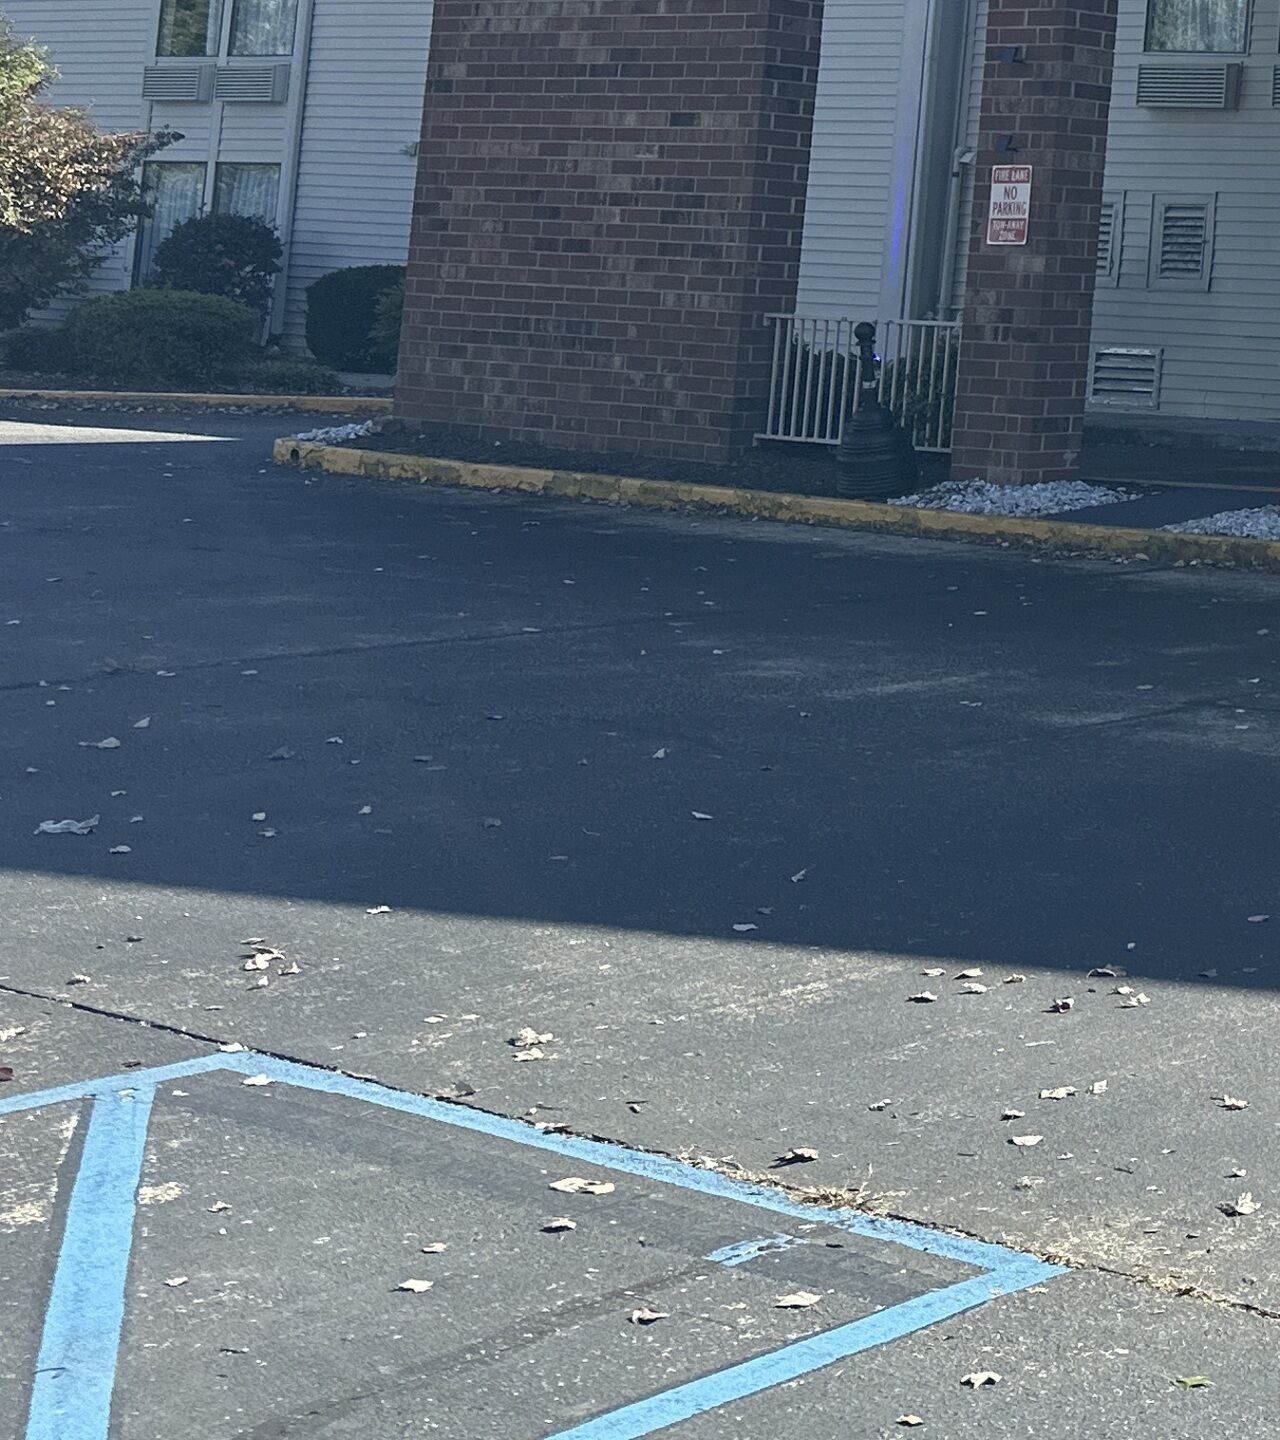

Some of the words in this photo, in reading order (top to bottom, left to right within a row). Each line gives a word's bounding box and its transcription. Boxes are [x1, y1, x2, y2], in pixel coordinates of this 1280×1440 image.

[995, 169, 1010, 181] FIRE
[1011, 169, 1029, 181] LANE
[1003, 186, 1018, 200] NO
[992, 201, 1027, 216] PARKING
